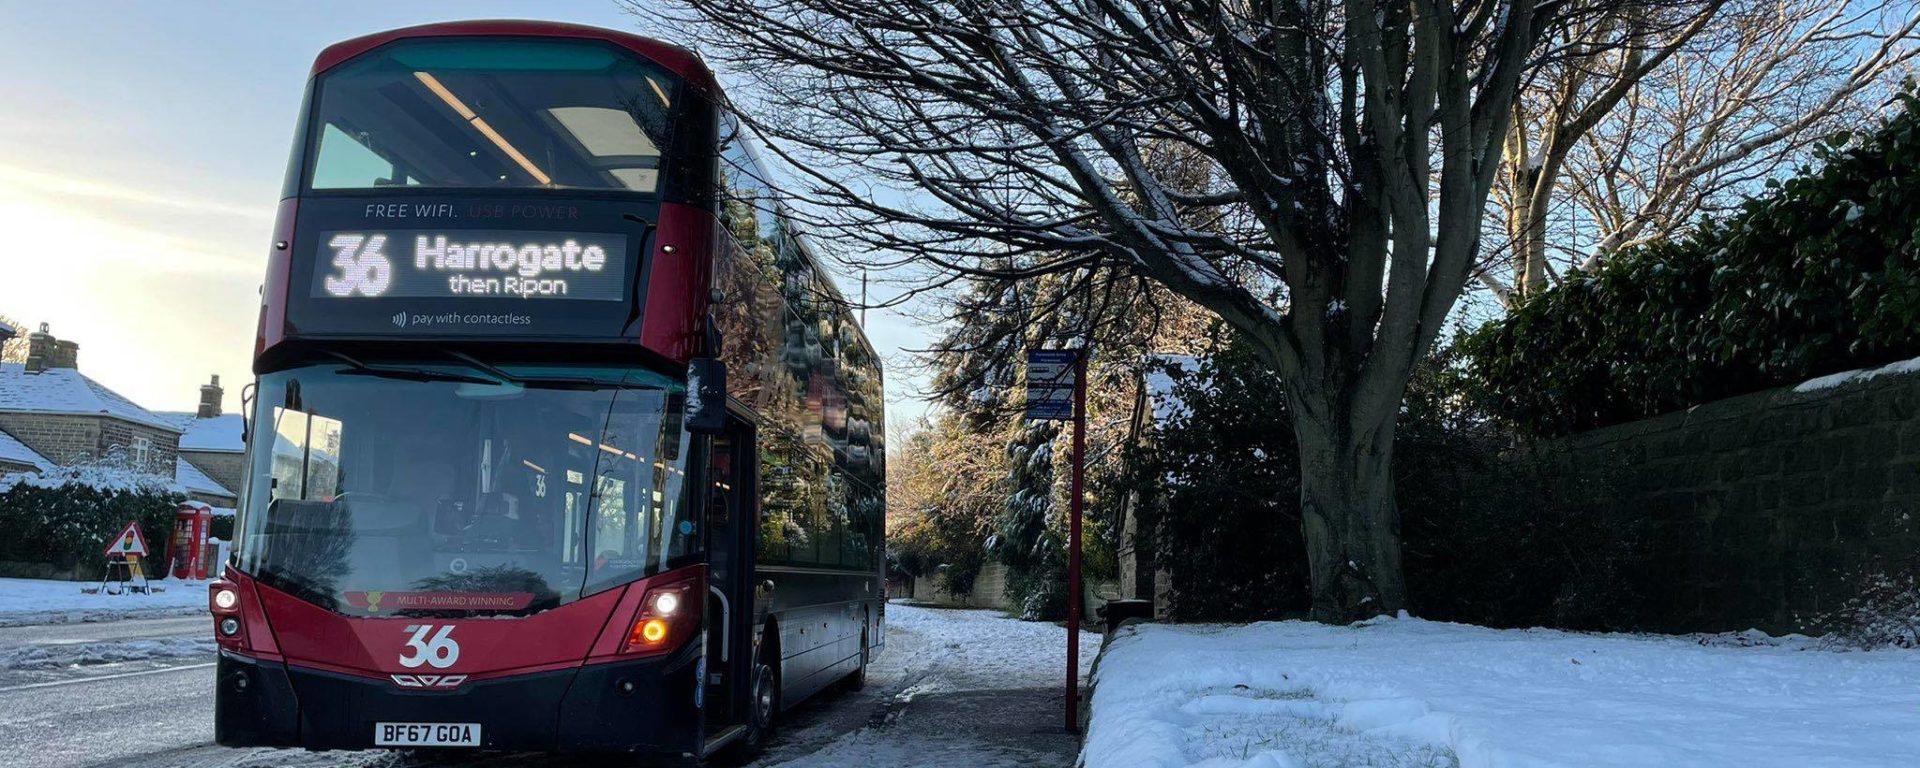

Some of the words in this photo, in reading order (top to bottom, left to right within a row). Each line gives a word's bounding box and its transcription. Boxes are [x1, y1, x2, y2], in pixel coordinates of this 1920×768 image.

[365, 204, 408, 218] FREE
[469, 205, 504, 218] USB
[512, 205, 579, 219] POWER
[325, 234, 391, 297] 36
[415, 235, 606, 277] Harrogate
[449, 274, 500, 294] then
[504, 276, 567, 298] Ripon
[412, 314, 434, 326] pay
[436, 312, 461, 324] with
[463, 312, 532, 325] contactless
[535, 474, 546, 498] 36
[397, 596, 466, 606] MULTI-AWARD
[468, 597, 515, 606] WINNING
[399, 624, 460, 668] 36
[383, 725, 431, 742] BF67
[436, 725, 472, 743] GOA
